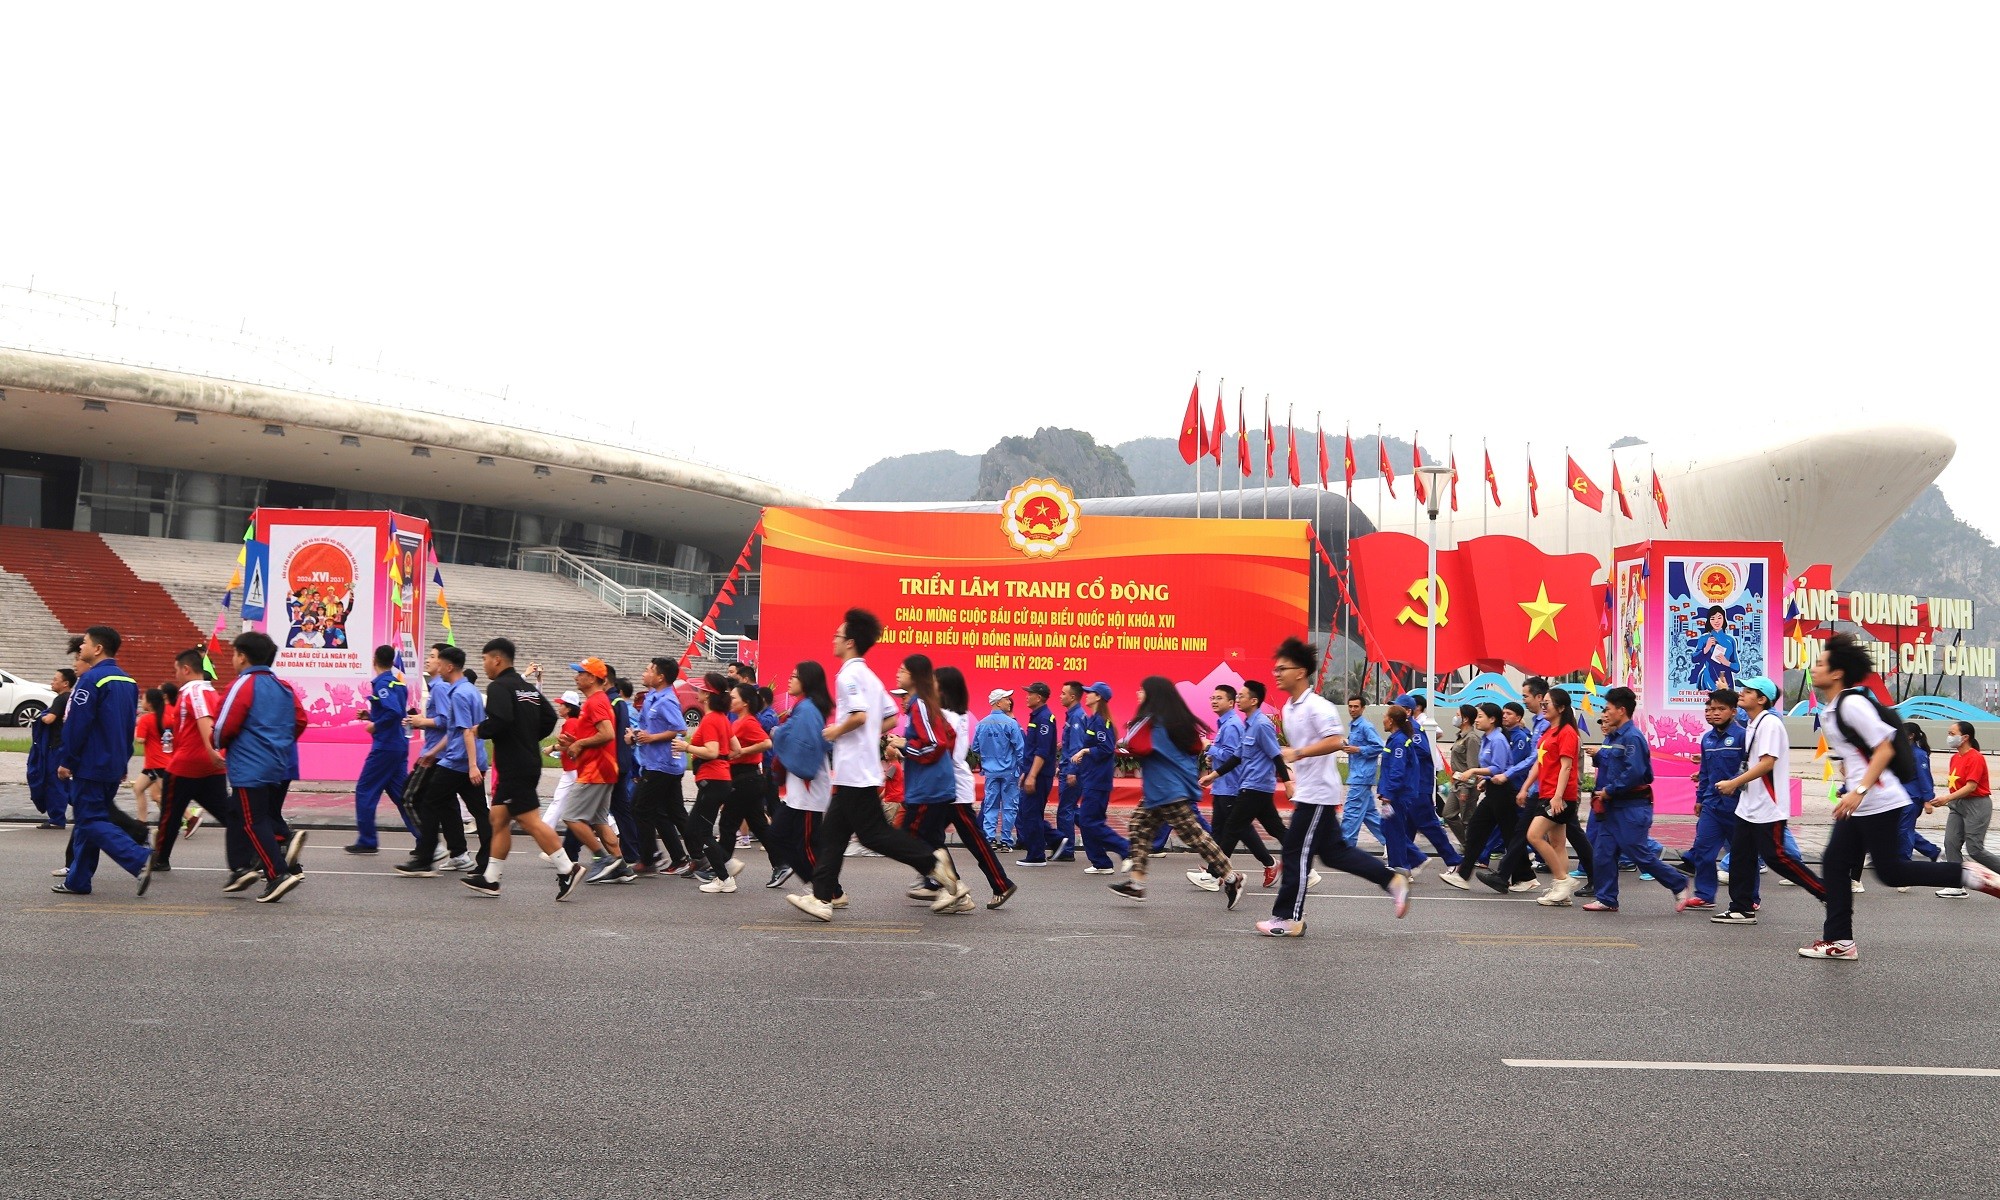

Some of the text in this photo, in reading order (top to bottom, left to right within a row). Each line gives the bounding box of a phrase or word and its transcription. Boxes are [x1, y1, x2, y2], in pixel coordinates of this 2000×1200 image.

[311, 571, 330, 583] XVI
[898, 571, 1170, 604] TRIỂN LÃM TRANH CỔ ĐỘNG
[895, 605, 1175, 629] CHÀO MỪNG CUỘC BẦU CỬ ĐẠI BIỂU QUỐC HỘI KHÓA XVI
[1849, 591, 1919, 627] QUANG
[1928, 597, 1974, 630] VINH
[876, 625, 1208, 652] ẦU CỬ ĐẠI BIỂU HỘI ĐỒNG NHÂN DÂN CÁC CẤP TỈNH QUẢNG NINH
[276, 661, 287, 669] ĐẠI
[287, 660, 304, 668] ĐOÀN
[305, 660, 316, 668] KẾT
[318, 661, 334, 669] TOÀN
[334, 661, 347, 669] DÂN
[298, 650, 311, 659] BẦU
[312, 649, 321, 659] CỬ
[321, 651, 329, 659] LÀ
[330, 651, 346, 660] NGÀY
[347, 652, 358, 660] HỘI
[975, 652, 1010, 671] NHIỆM
[1012, 653, 1026, 669] KỲ
[1028, 655, 1054, 670] 2026
[1063, 656, 1087, 671] 2031
[1899, 632, 1937, 675] CẤT
[1944, 640, 1996, 678] CÁNH
